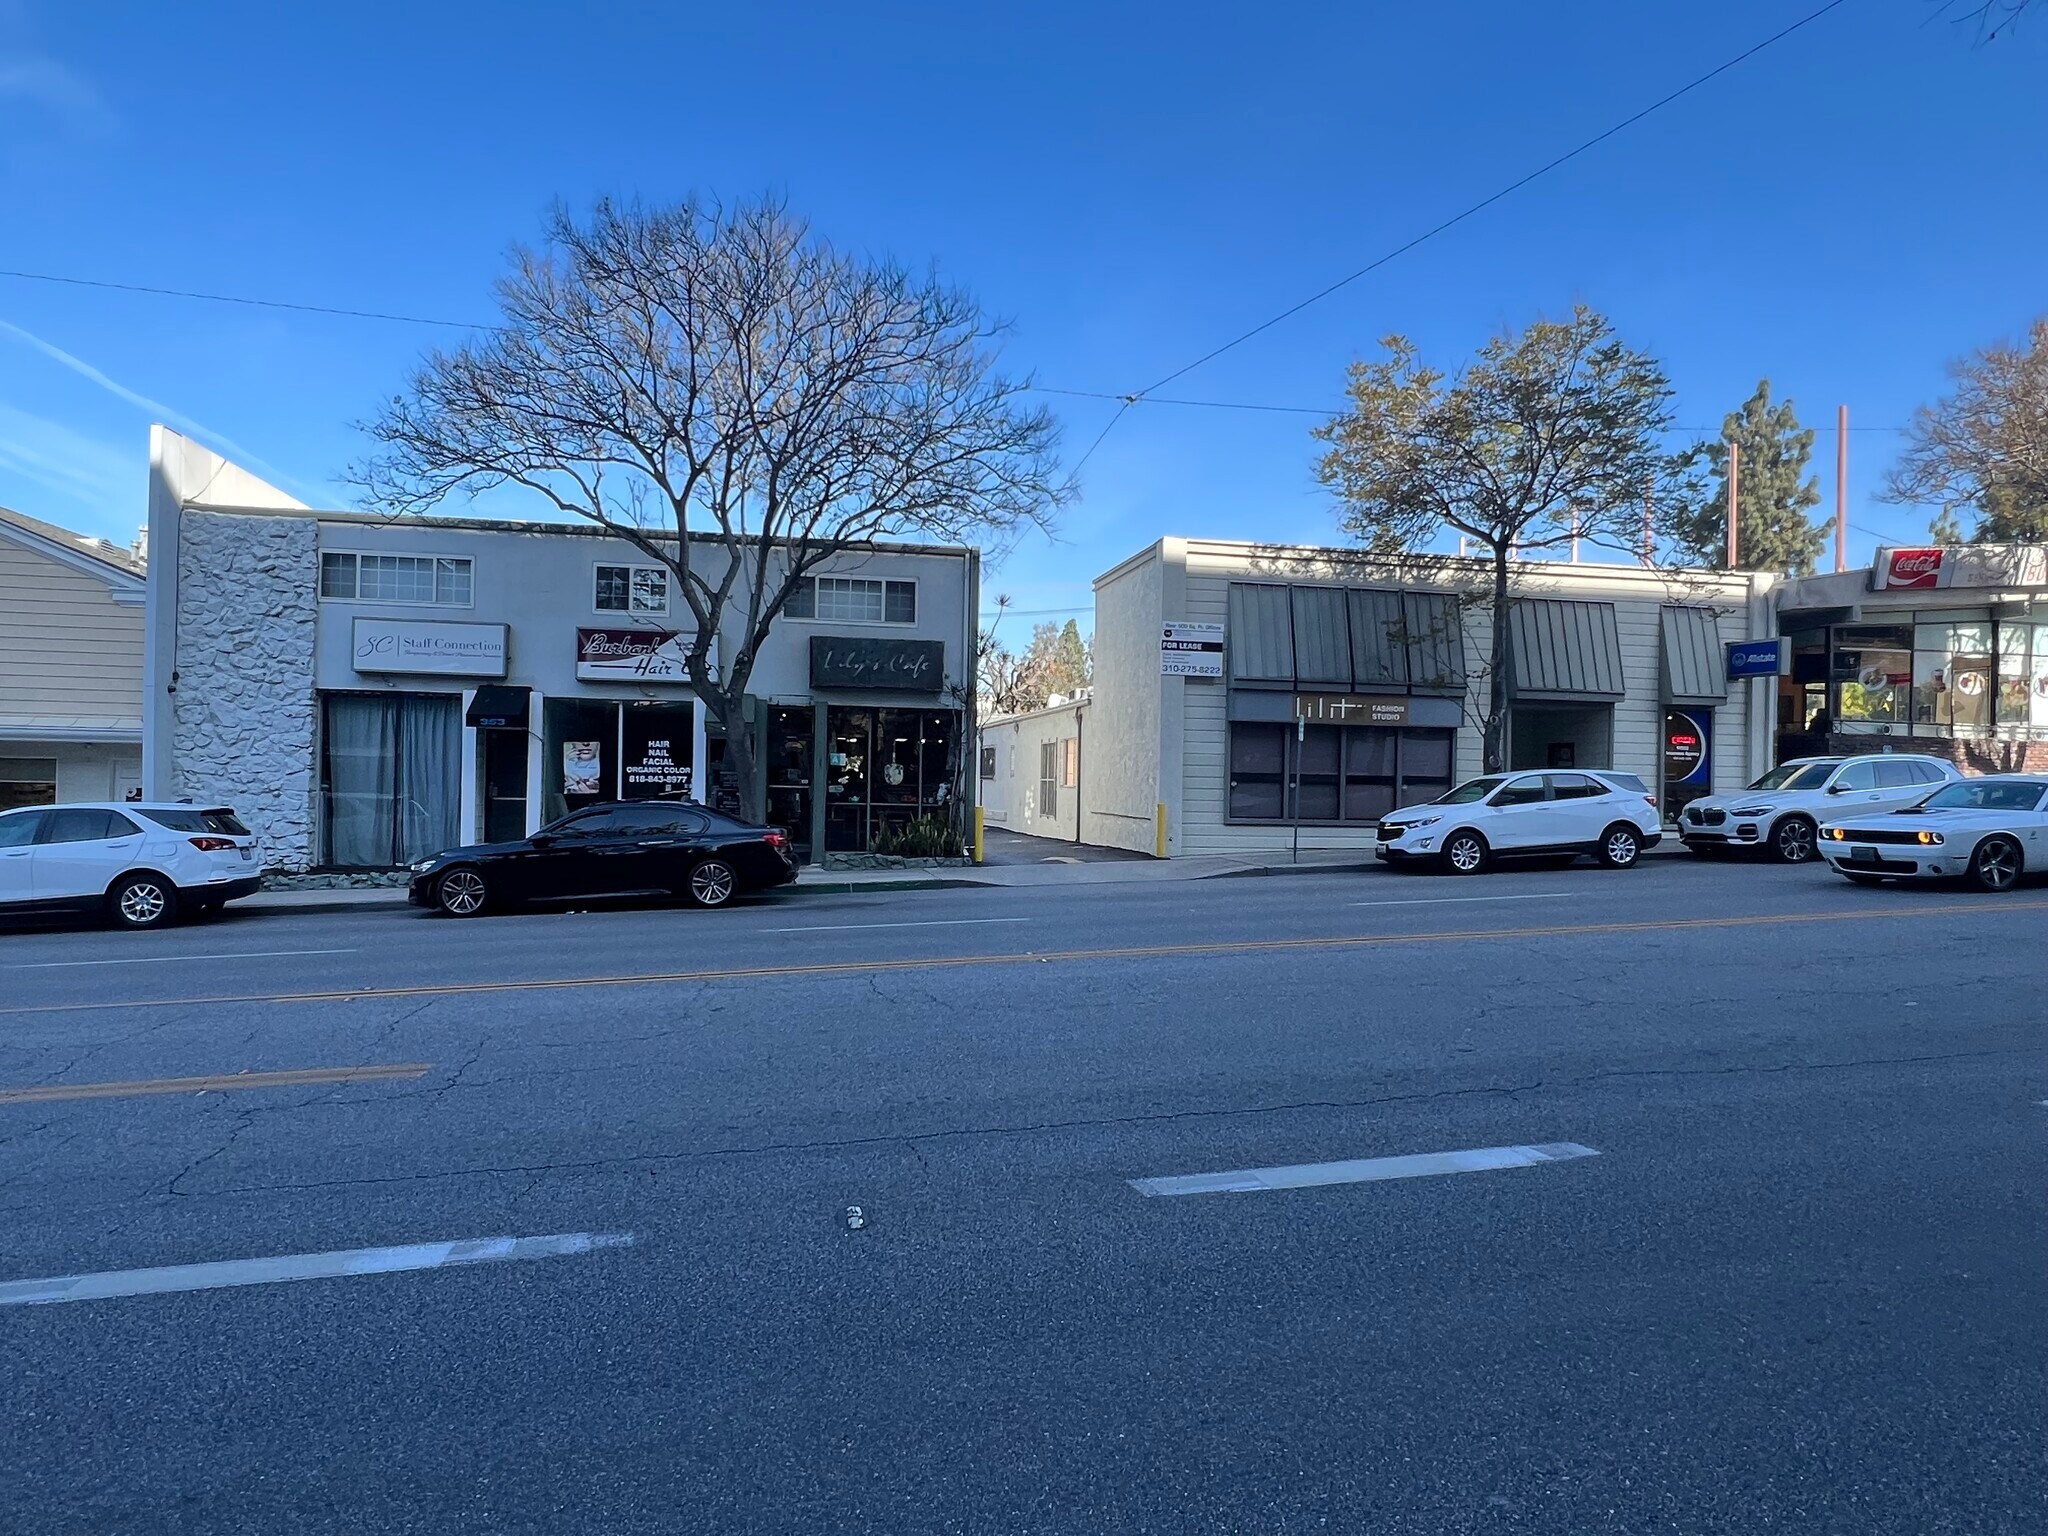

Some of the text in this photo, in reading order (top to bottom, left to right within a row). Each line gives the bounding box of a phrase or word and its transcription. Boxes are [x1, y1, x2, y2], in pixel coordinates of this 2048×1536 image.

[403, 637, 502, 651] Staff Connection
[582, 633, 660, 655] Burbank
[1179, 642, 1203, 650] LEASE
[633, 656, 673, 676] Hair
[1372, 704, 1405, 713] FASHION
[1372, 713, 1400, 721] STUDIO
[479, 718, 506, 726] 353
[648, 740, 670, 748] HAIR
[1671, 736, 1696, 744] OPEN
[648, 749, 669, 757] NAIL
[643, 758, 674, 766] FACIAL
[626, 766, 662, 774] ORGANIC
